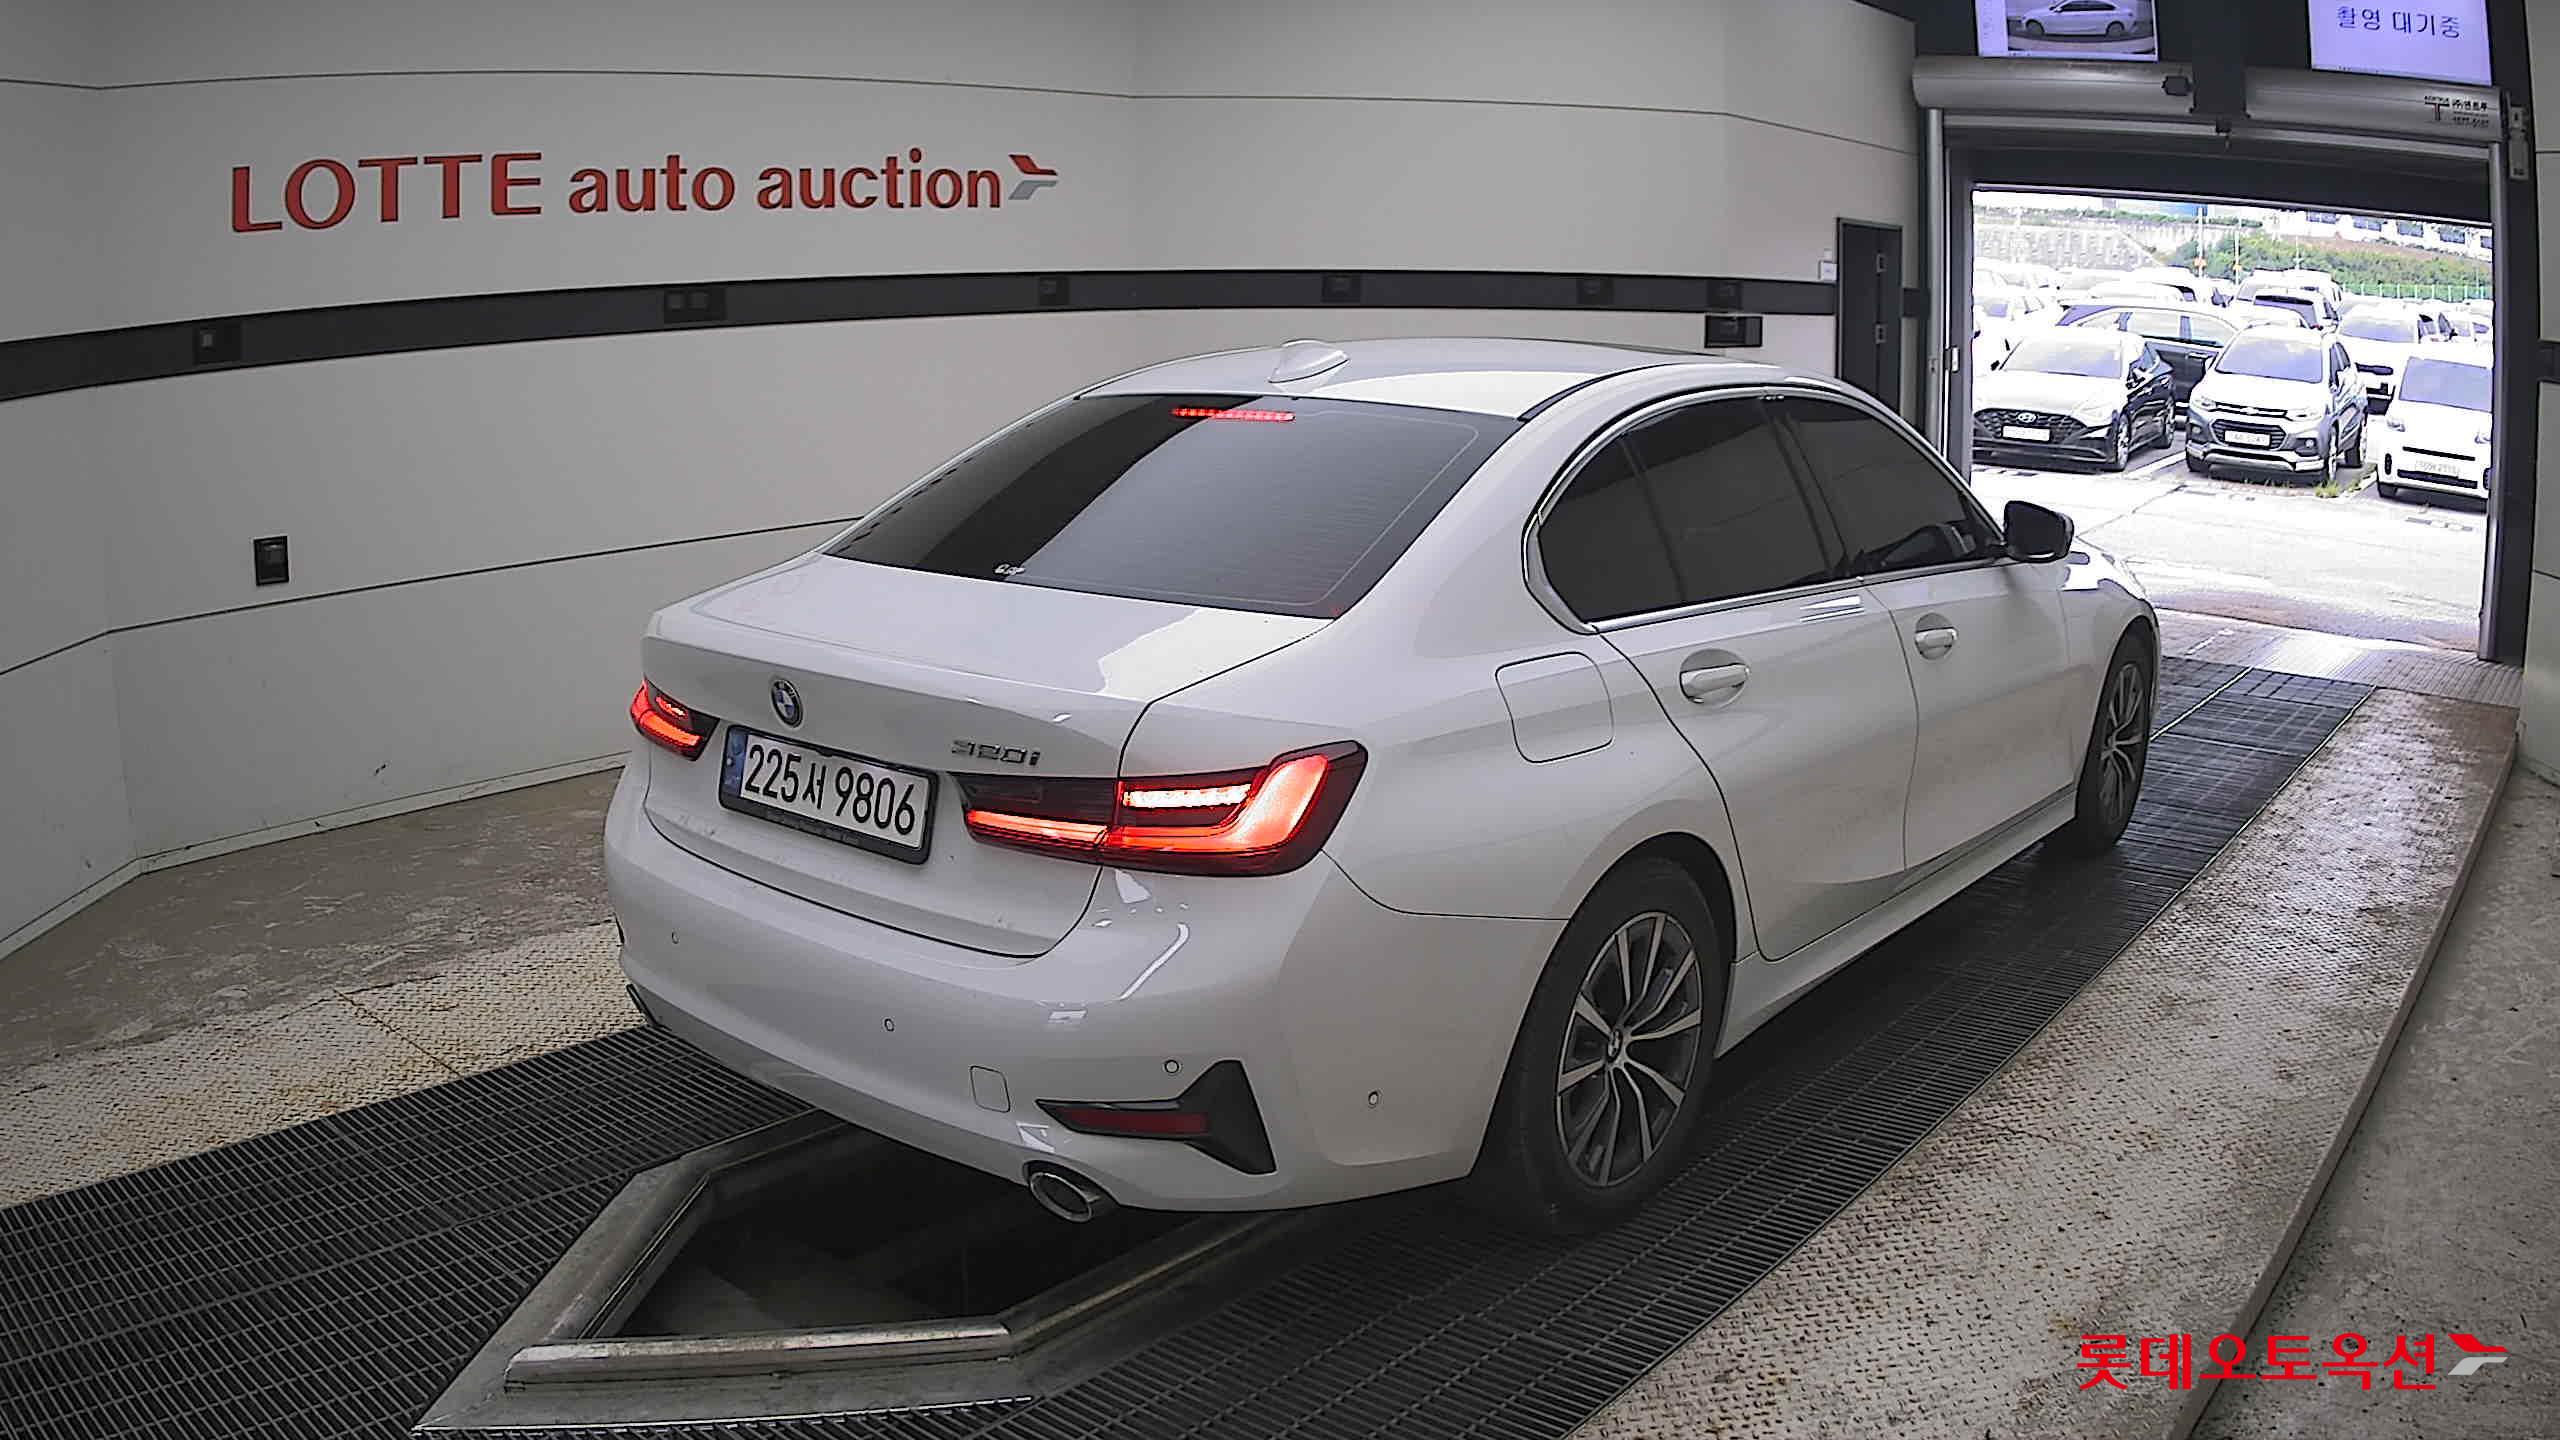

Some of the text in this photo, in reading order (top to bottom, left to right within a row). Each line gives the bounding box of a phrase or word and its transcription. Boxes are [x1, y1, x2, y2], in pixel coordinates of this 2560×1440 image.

[2337, 6, 2460, 39] 촬영 대기중
[232, 147, 1001, 233] LOTTE auto auction
[951, 740, 1041, 766] 320i
[744, 744, 916, 836] 225서 9806
